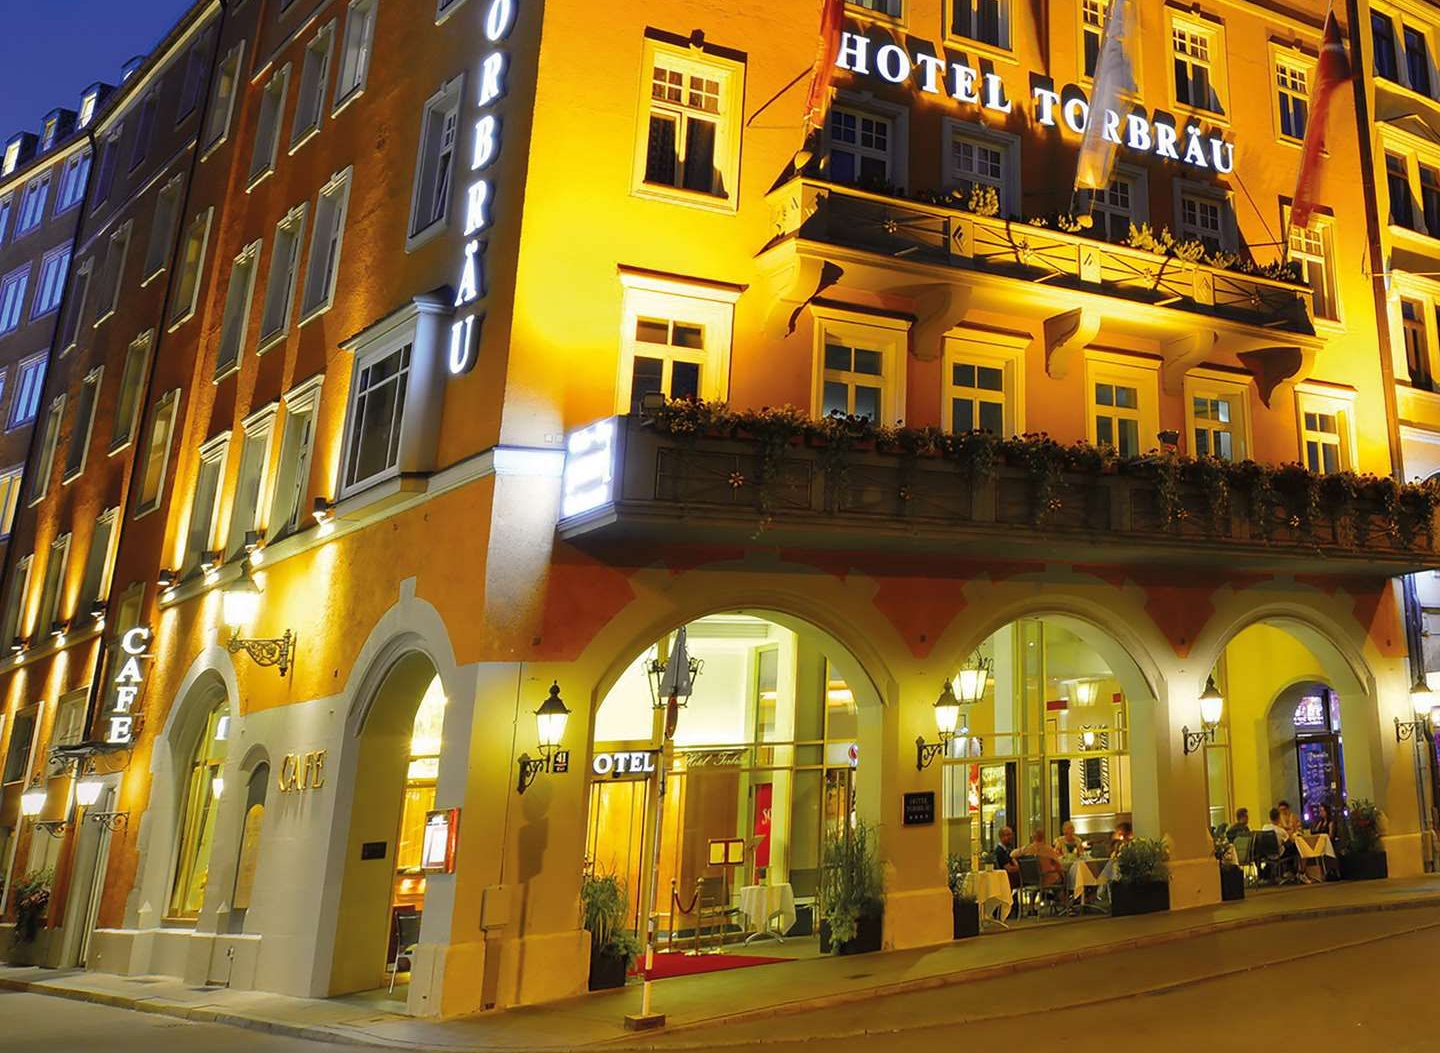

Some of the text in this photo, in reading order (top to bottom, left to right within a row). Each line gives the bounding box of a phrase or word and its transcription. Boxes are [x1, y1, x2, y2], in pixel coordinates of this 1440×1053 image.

[835, 31, 1234, 174] HOTEL TORBRÄU
[107, 627, 149, 744] CAFE
[555, 751, 567, 764] 41
